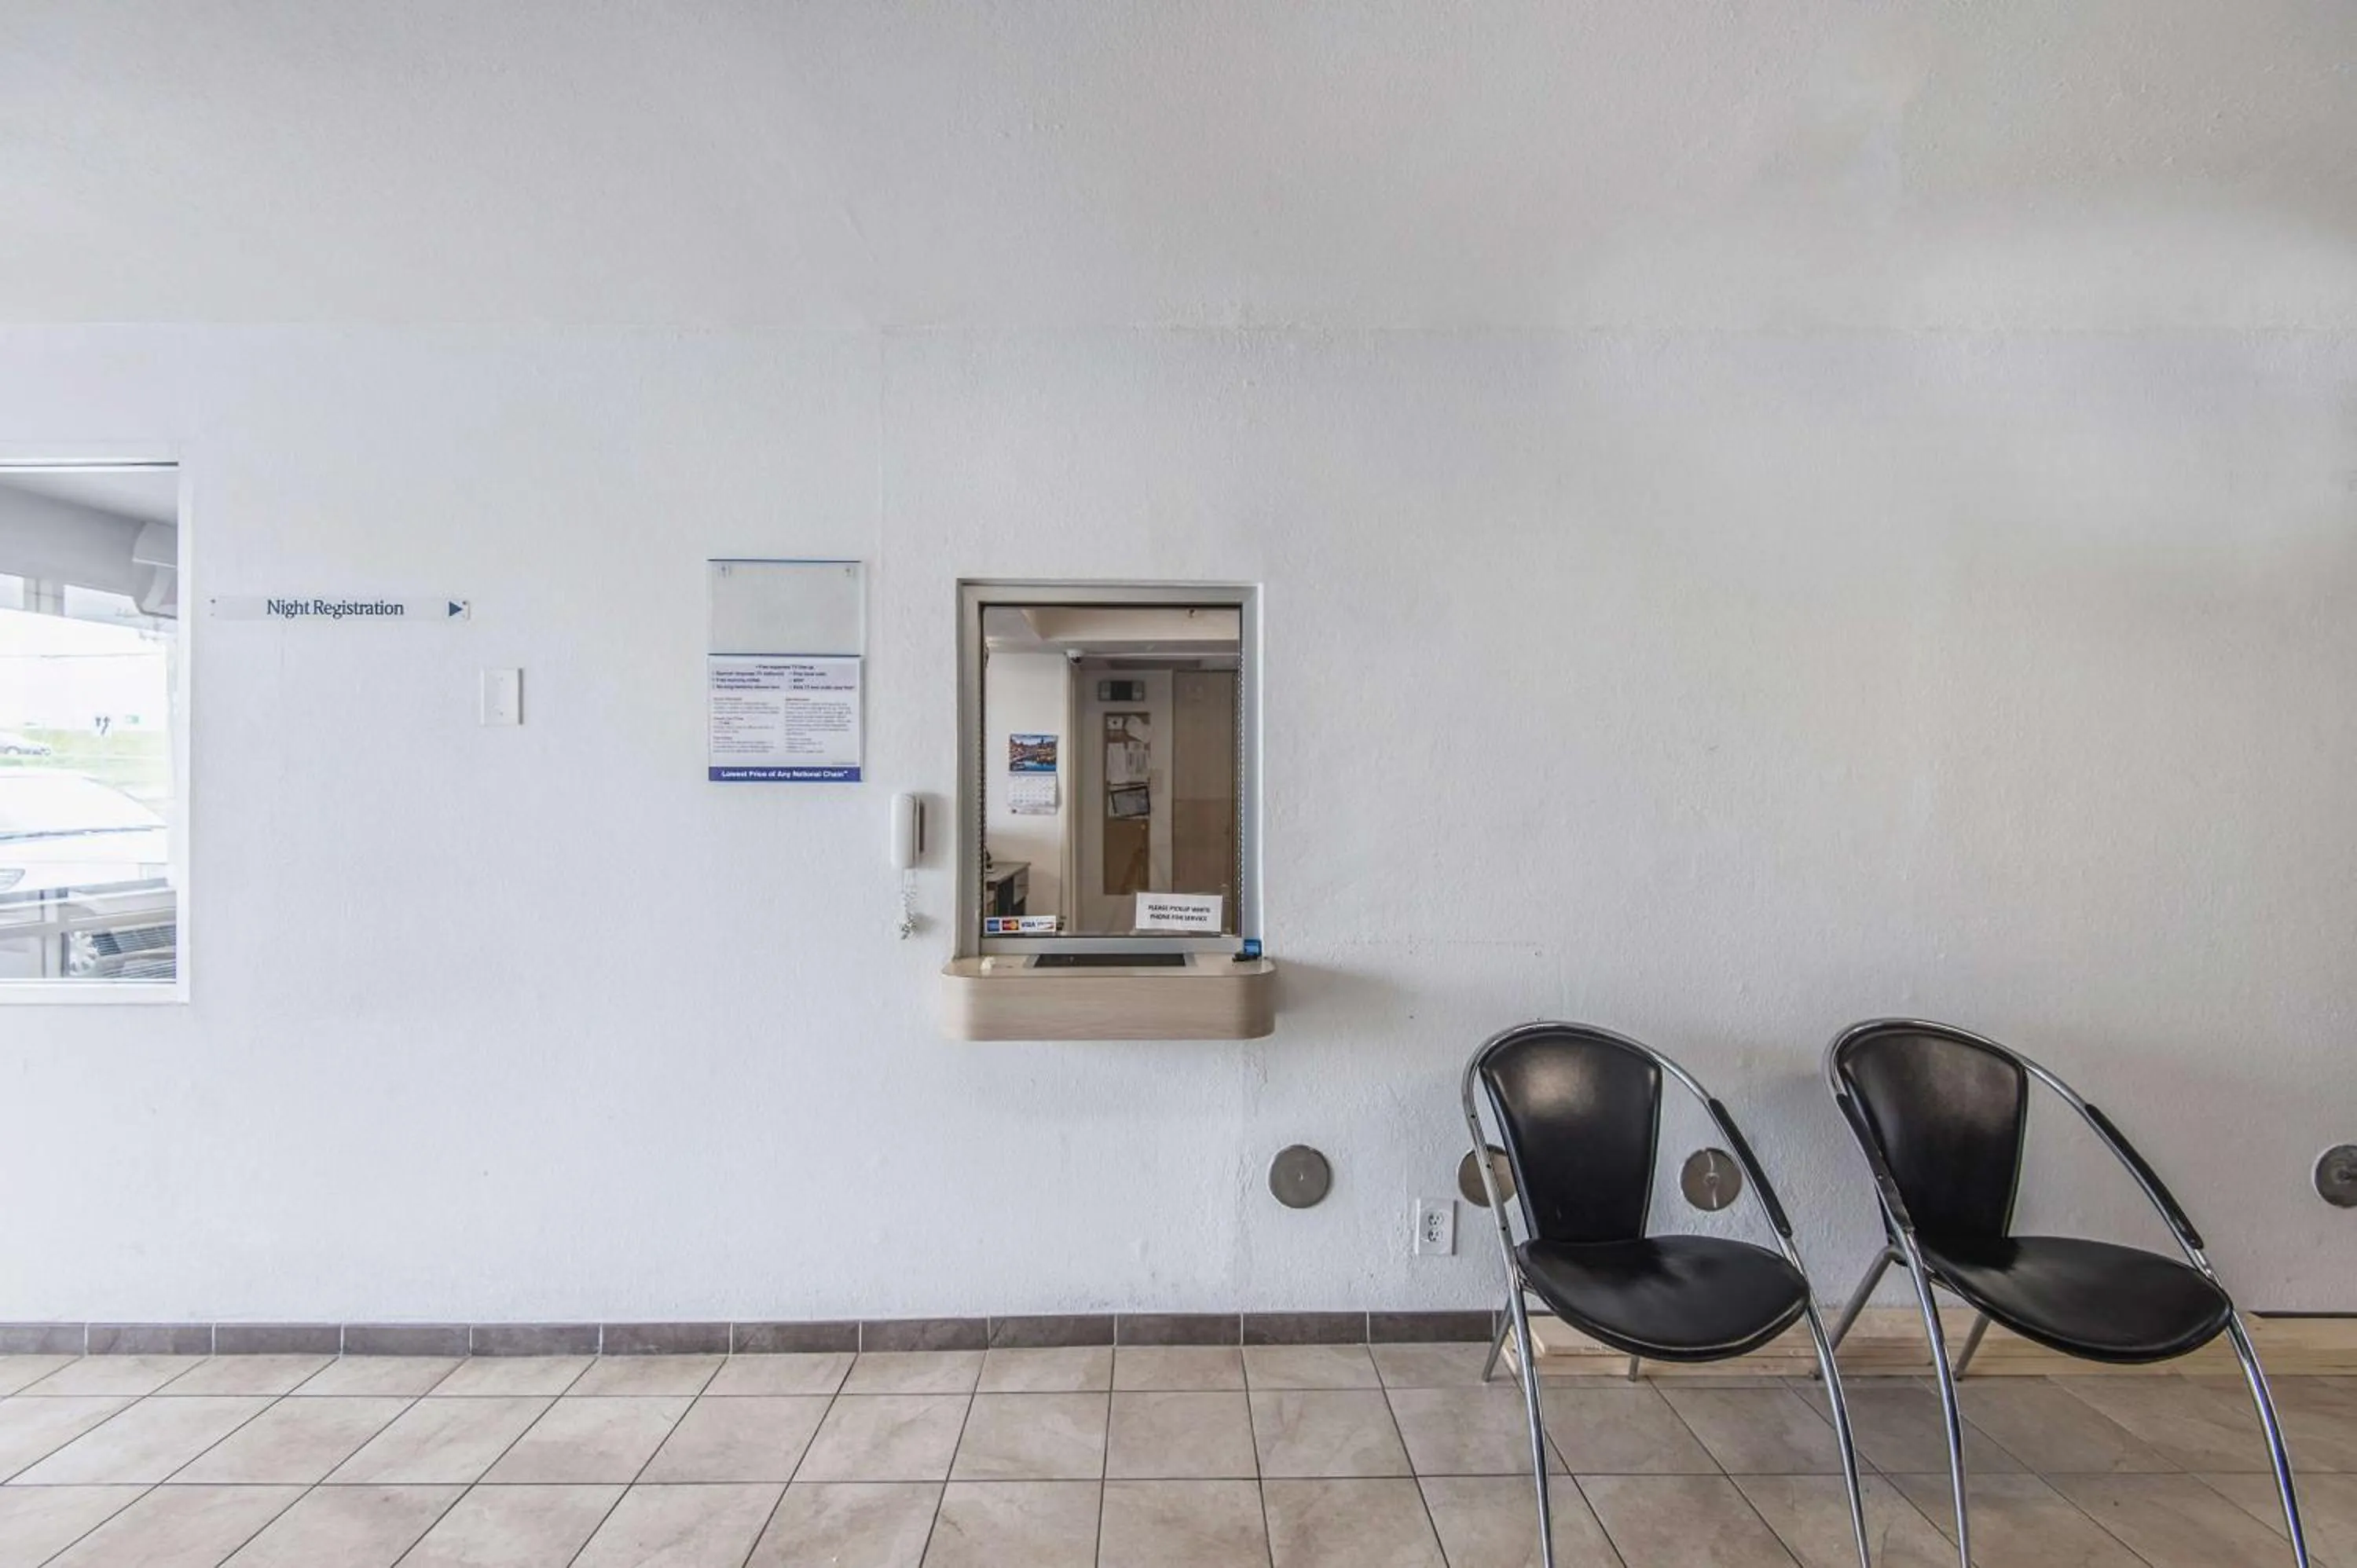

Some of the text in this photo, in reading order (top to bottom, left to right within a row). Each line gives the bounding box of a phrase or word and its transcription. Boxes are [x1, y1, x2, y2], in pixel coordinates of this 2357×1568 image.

[266, 599, 404, 619] Night Registration
[777, 771, 790, 779] Any
